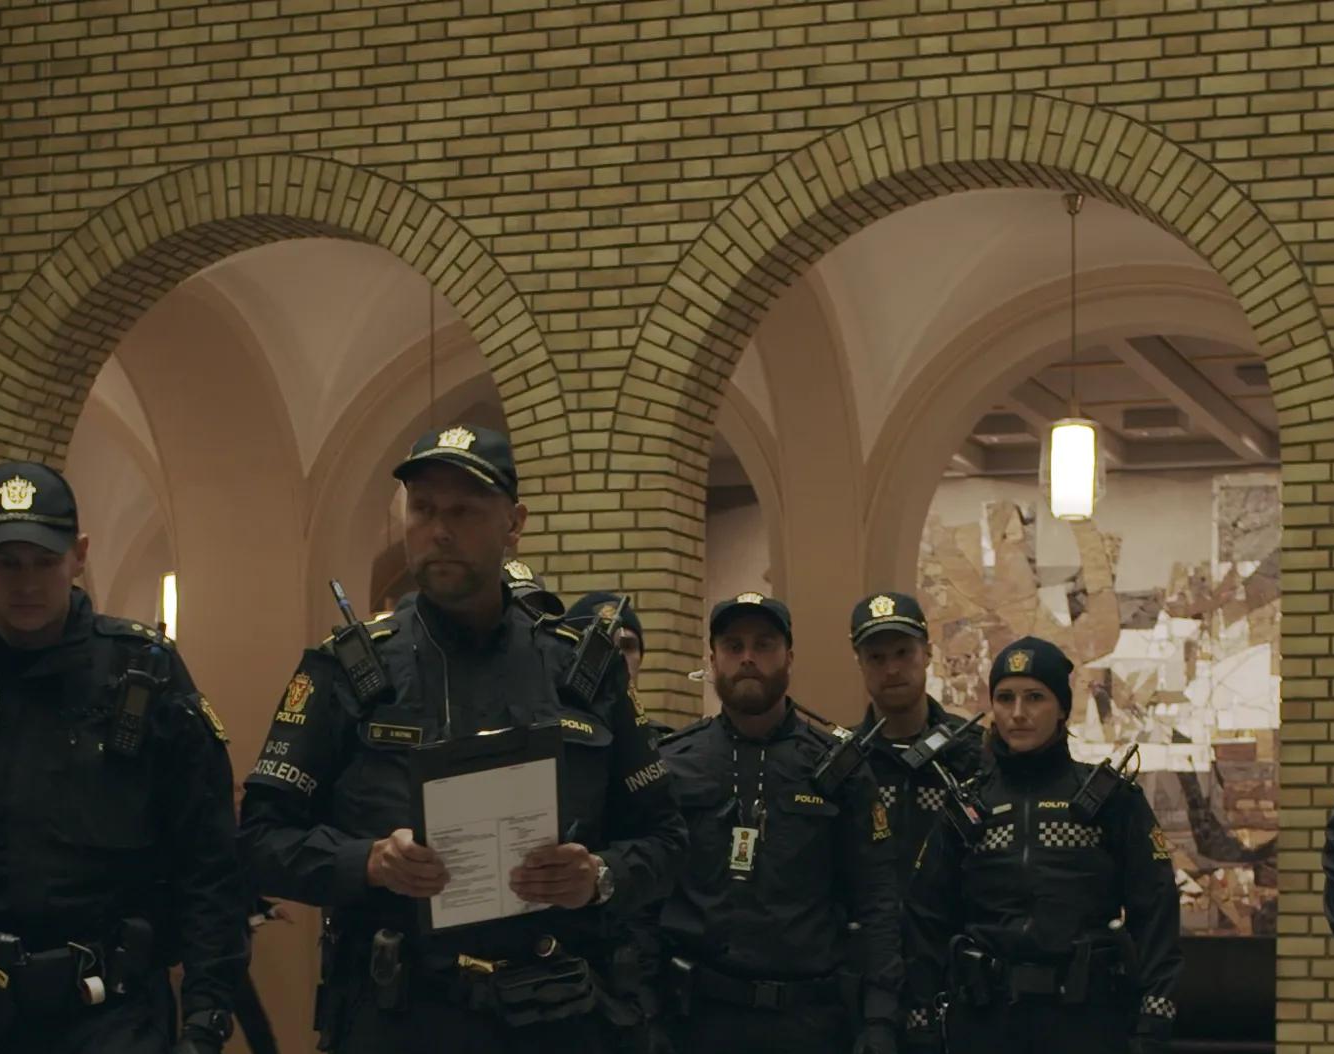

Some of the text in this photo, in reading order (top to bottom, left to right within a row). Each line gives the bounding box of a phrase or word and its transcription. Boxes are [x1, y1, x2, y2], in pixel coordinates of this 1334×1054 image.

[275, 711, 307, 725] POLITI
[559, 719, 594, 735] POLITI
[794, 793, 825, 805] POLITI
[1037, 800, 1070, 810] POLITI
